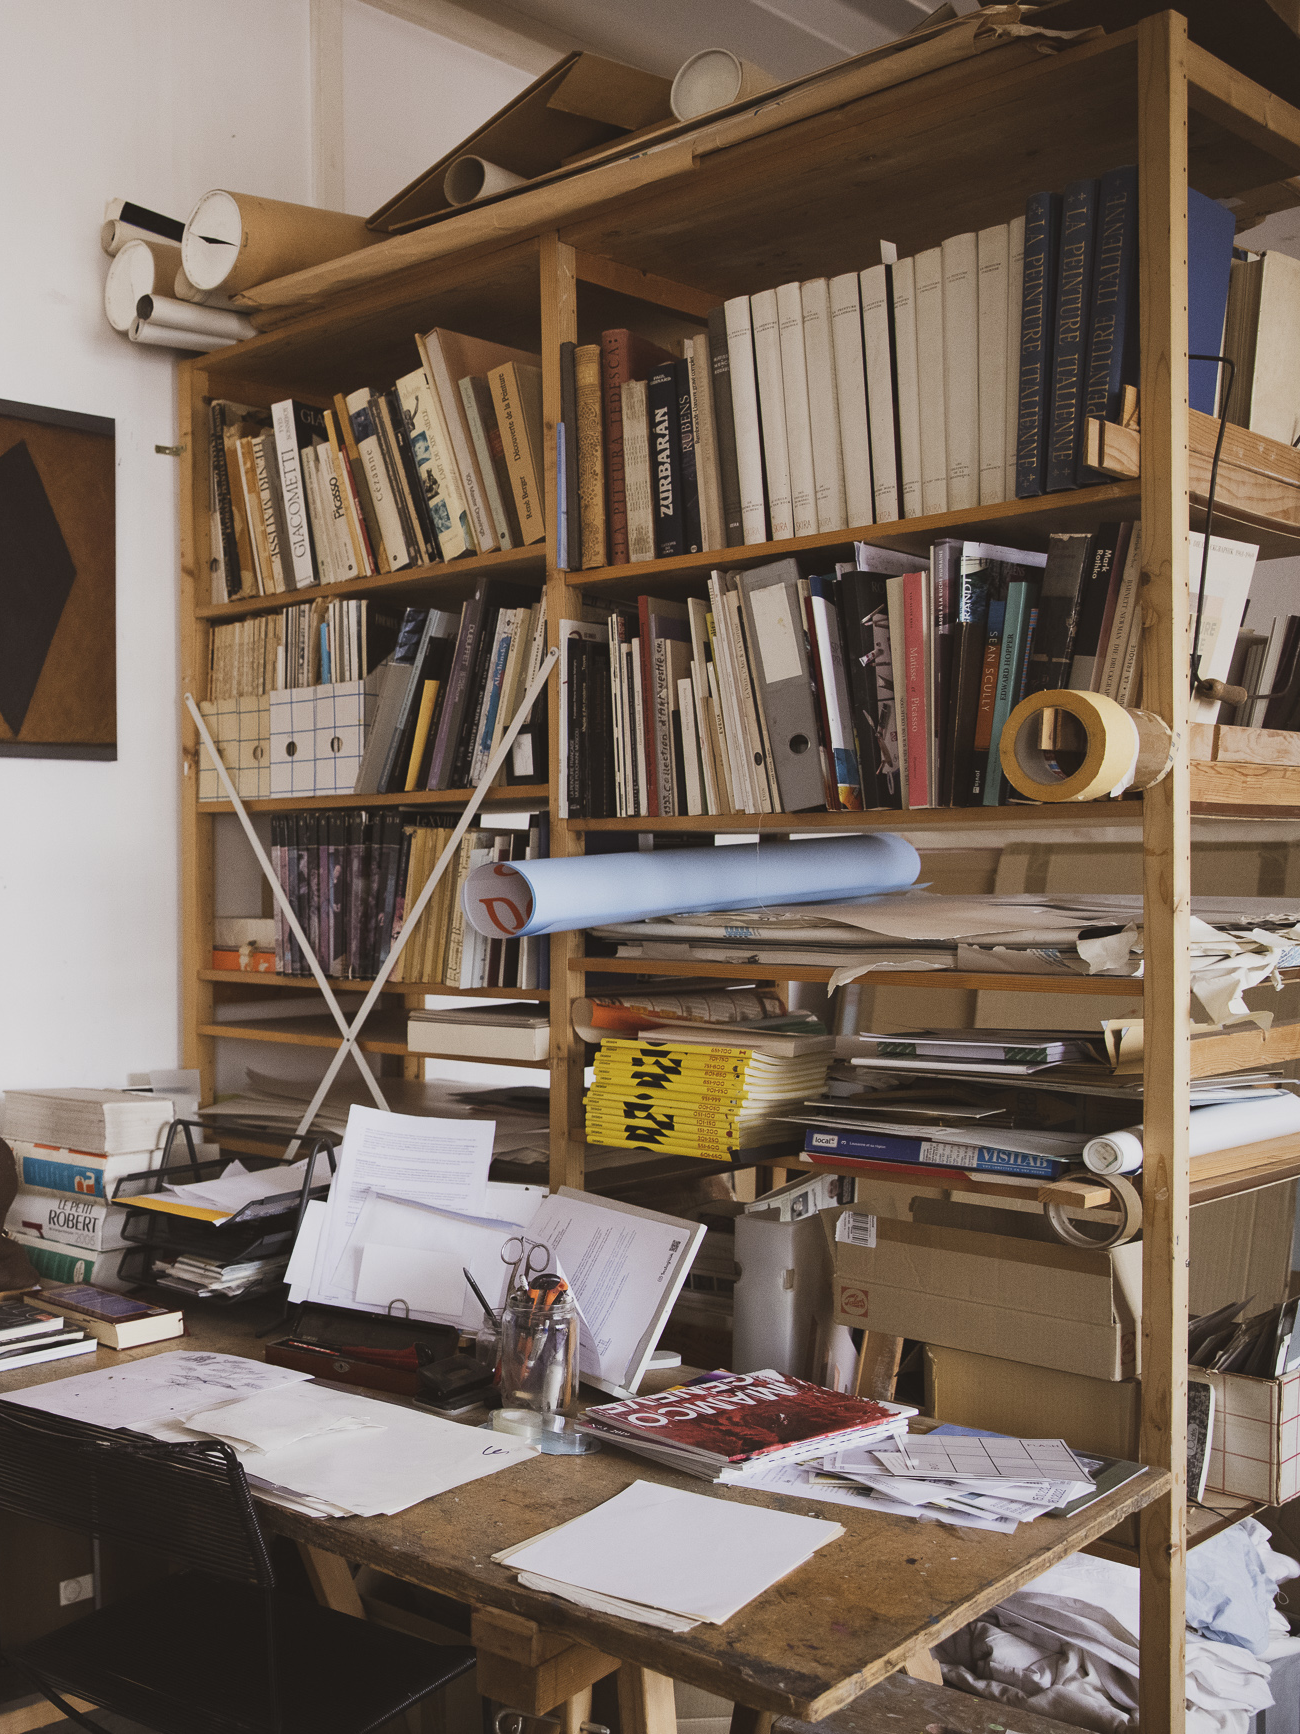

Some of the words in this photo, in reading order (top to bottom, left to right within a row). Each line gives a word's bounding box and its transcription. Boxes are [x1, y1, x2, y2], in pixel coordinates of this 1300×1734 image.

[1026, 218, 1045, 246] LA
[1065, 206, 1087, 235] LA
[1097, 192, 1127, 305] ITALIENNE
[1022, 252, 1045, 355] PEINTURE
[1058, 240, 1086, 345] PEINTURE
[608, 346, 622, 424] TEDESCA
[1086, 314, 1116, 418] PEINTURE
[498, 373, 508, 403] Peinture
[1052, 352, 1079, 462] ITALIENNE
[679, 394, 694, 454] RUBENS
[1018, 362, 1040, 469] ITALIENNE
[507, 421, 521, 462] Découverte
[653, 406, 674, 518] ZURBARÁN
[366, 449, 382, 502] Cézanne
[519, 475, 530, 499] Berger
[611, 437, 626, 515] PITTURA
[281, 448, 307, 559] GIACOMETTI
[329, 477, 345, 520] Picasso
[523, 499, 533, 520] René
[613, 525, 626, 547] LA
[1091, 549, 1104, 579] Rothko
[1101, 549, 1113, 573] Mark
[463, 624, 475, 667] DUBUFFET
[494, 642, 508, 687] Alechinsky
[909, 647, 917, 682] Matisse
[989, 631, 998, 662] SEAN
[1000, 667, 1010, 701] EDWARD
[1005, 633, 1014, 666] HOPPER
[1126, 644, 1136, 670] FRESQUE
[981, 668, 995, 712] SCULLY
[1124, 671, 1130, 684] LA
[814, 1136, 832, 1145] local
[48, 1209, 100, 1233] ROBERT
[58, 1200, 69, 1210] LE
[70, 1201, 94, 1215] PETIT
[627, 1379, 800, 1427] MAMCO
